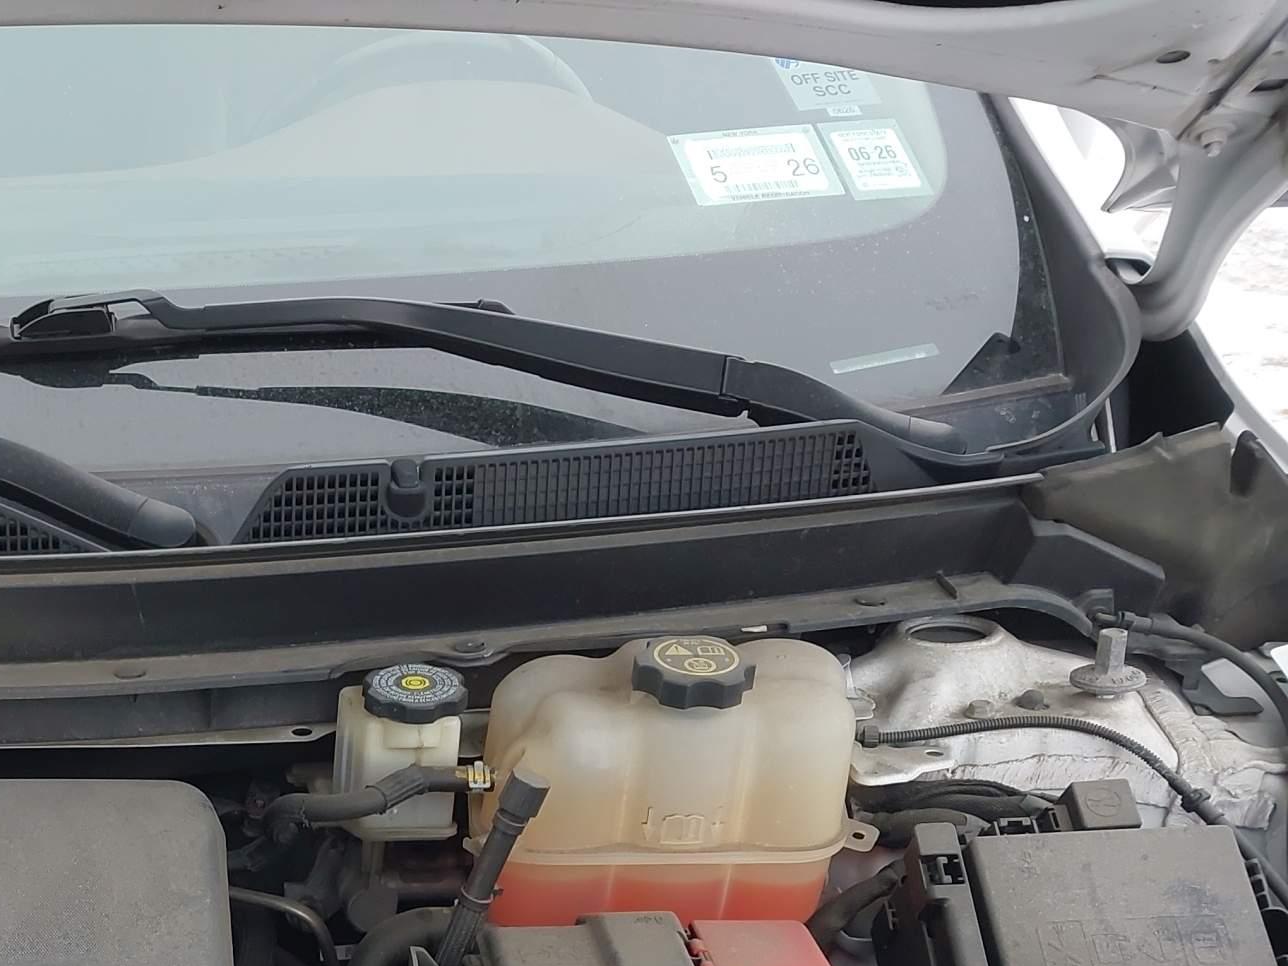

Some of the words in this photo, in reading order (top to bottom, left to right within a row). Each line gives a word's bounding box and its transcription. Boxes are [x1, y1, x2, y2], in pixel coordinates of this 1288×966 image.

[790, 72, 820, 86] OFF
[824, 70, 859, 82] SITE
[813, 84, 851, 97] SCC
[848, 146, 871, 161] 06
[874, 145, 897, 160] 26
[710, 165, 728, 183] 5
[786, 157, 820, 177] 26
